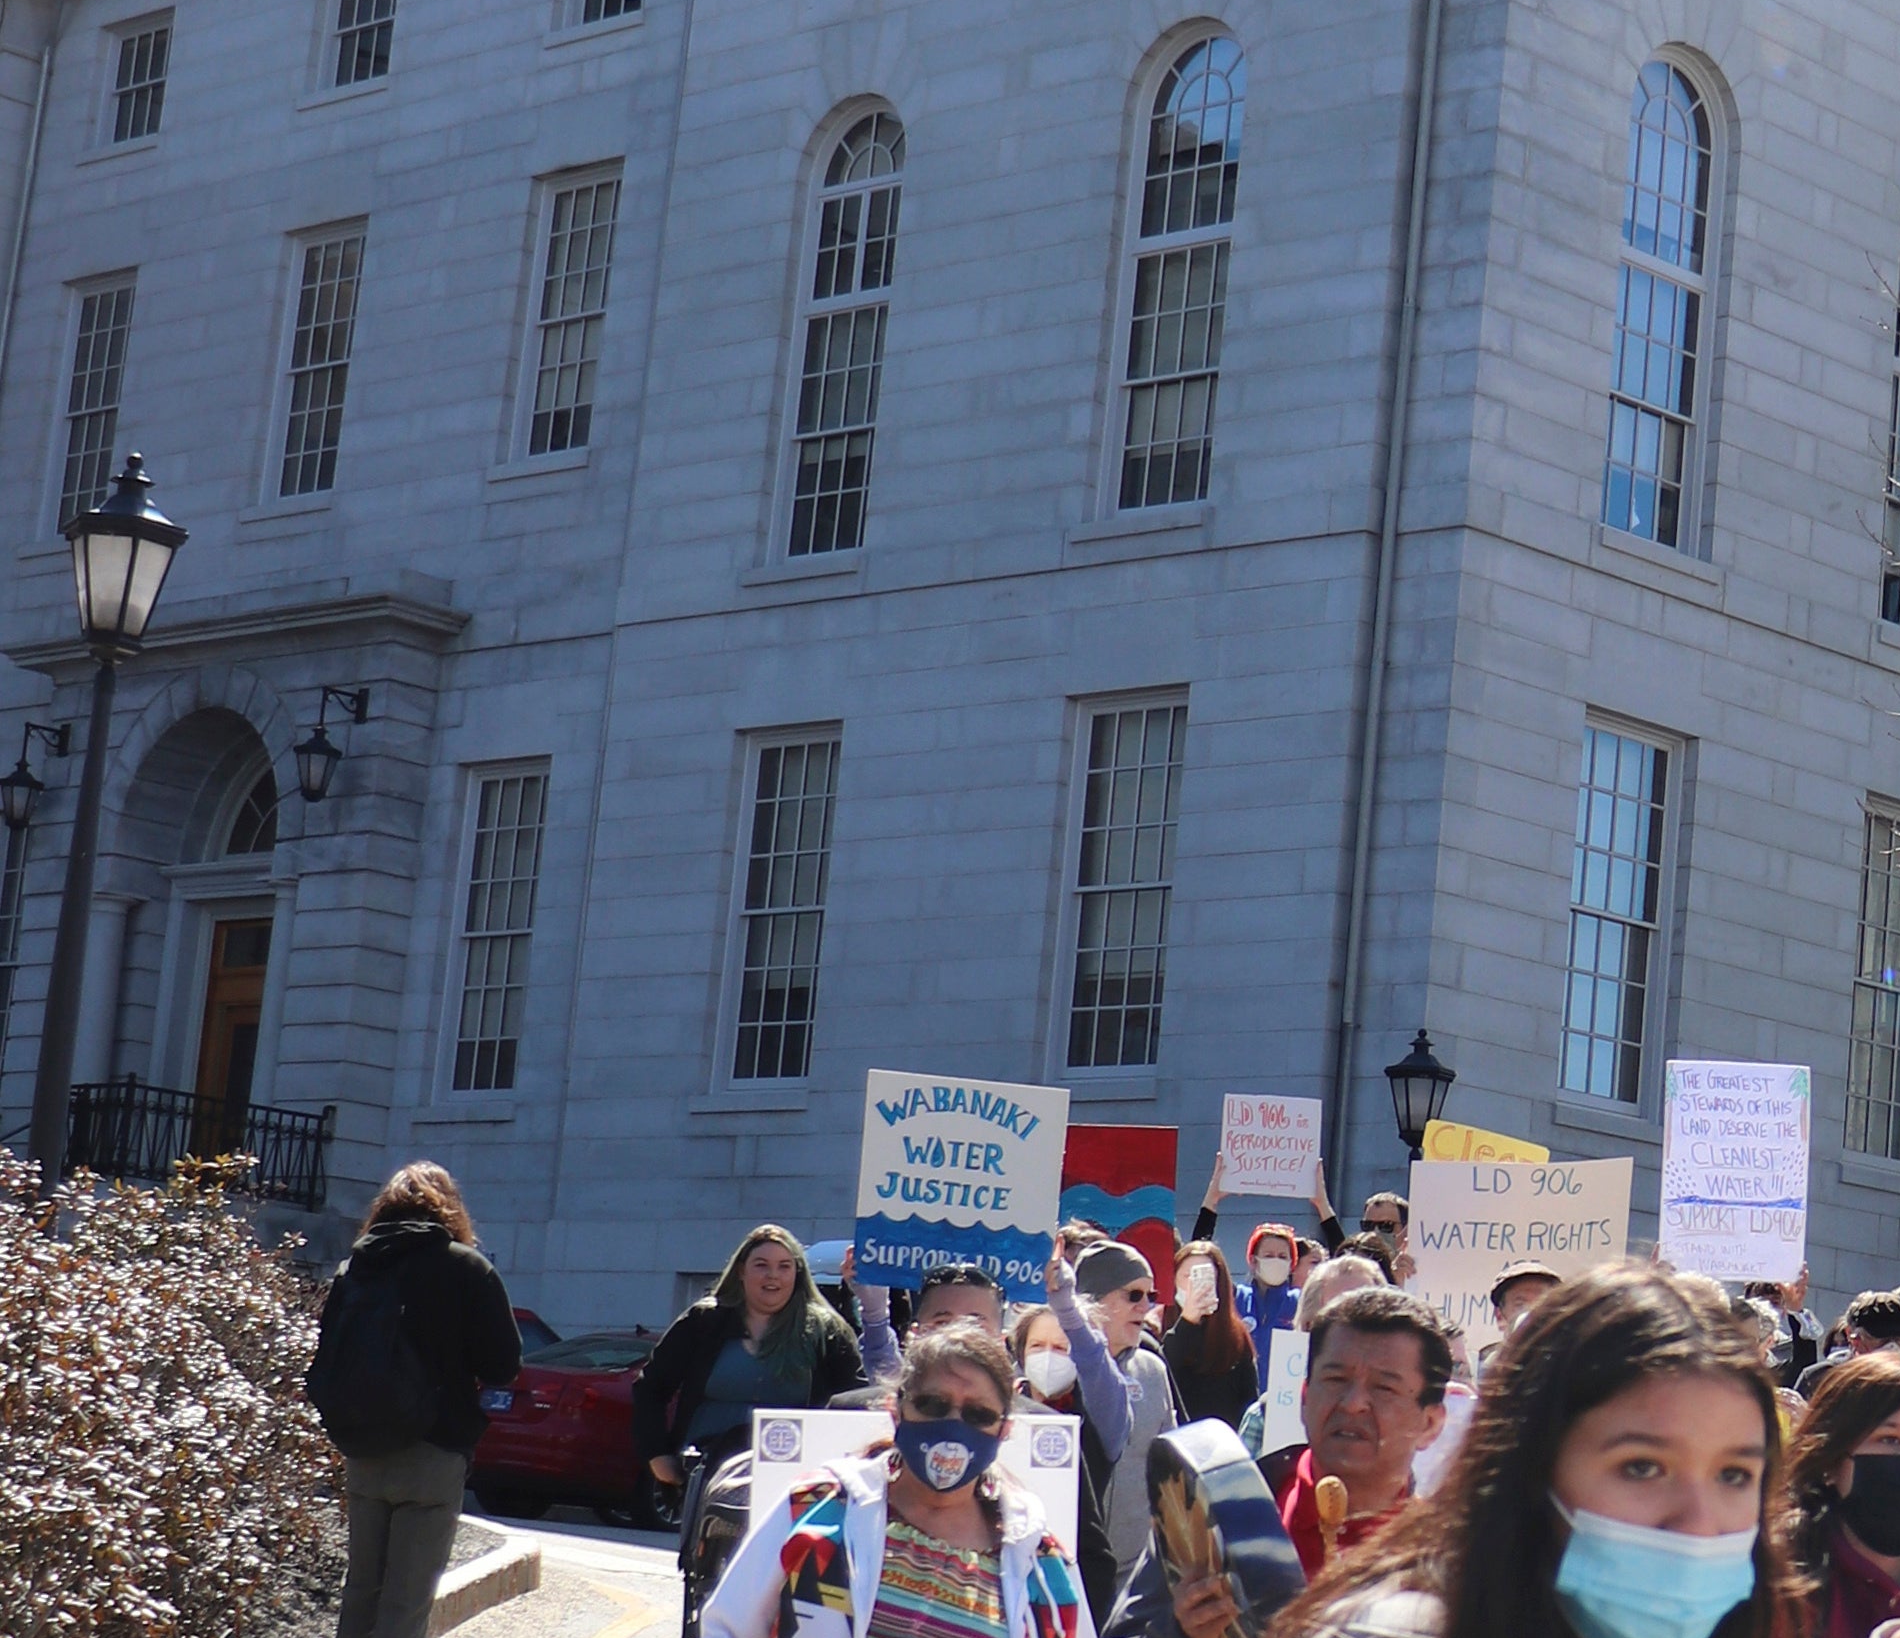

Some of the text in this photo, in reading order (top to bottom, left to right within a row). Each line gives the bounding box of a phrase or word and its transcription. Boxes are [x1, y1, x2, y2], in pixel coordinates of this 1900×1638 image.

[1677, 1069, 1775, 1094] THE GREATEST
[875, 1086, 1041, 1141] WABANAKI
[1227, 1098, 1254, 1127] LD
[1258, 1101, 1291, 1130] 906
[1679, 1093, 1793, 1117] STEWARDS OF THIS
[1680, 1116, 1798, 1139] LAND DESERVE THE
[1226, 1129, 1315, 1158] REPRODUCTIVE
[1691, 1142, 1782, 1170] CLEANEST
[1231, 1152, 1306, 1176] JUSTICE!
[875, 1172, 1013, 1211] JUSTICE
[1472, 1166, 1583, 1197] LD 906
[1705, 1174, 1768, 1198] WATER
[1666, 1205, 1742, 1232] SUPPORT
[1420, 1218, 1612, 1253] WATER RIGHTS
[1004, 1260, 1044, 1286] 906
